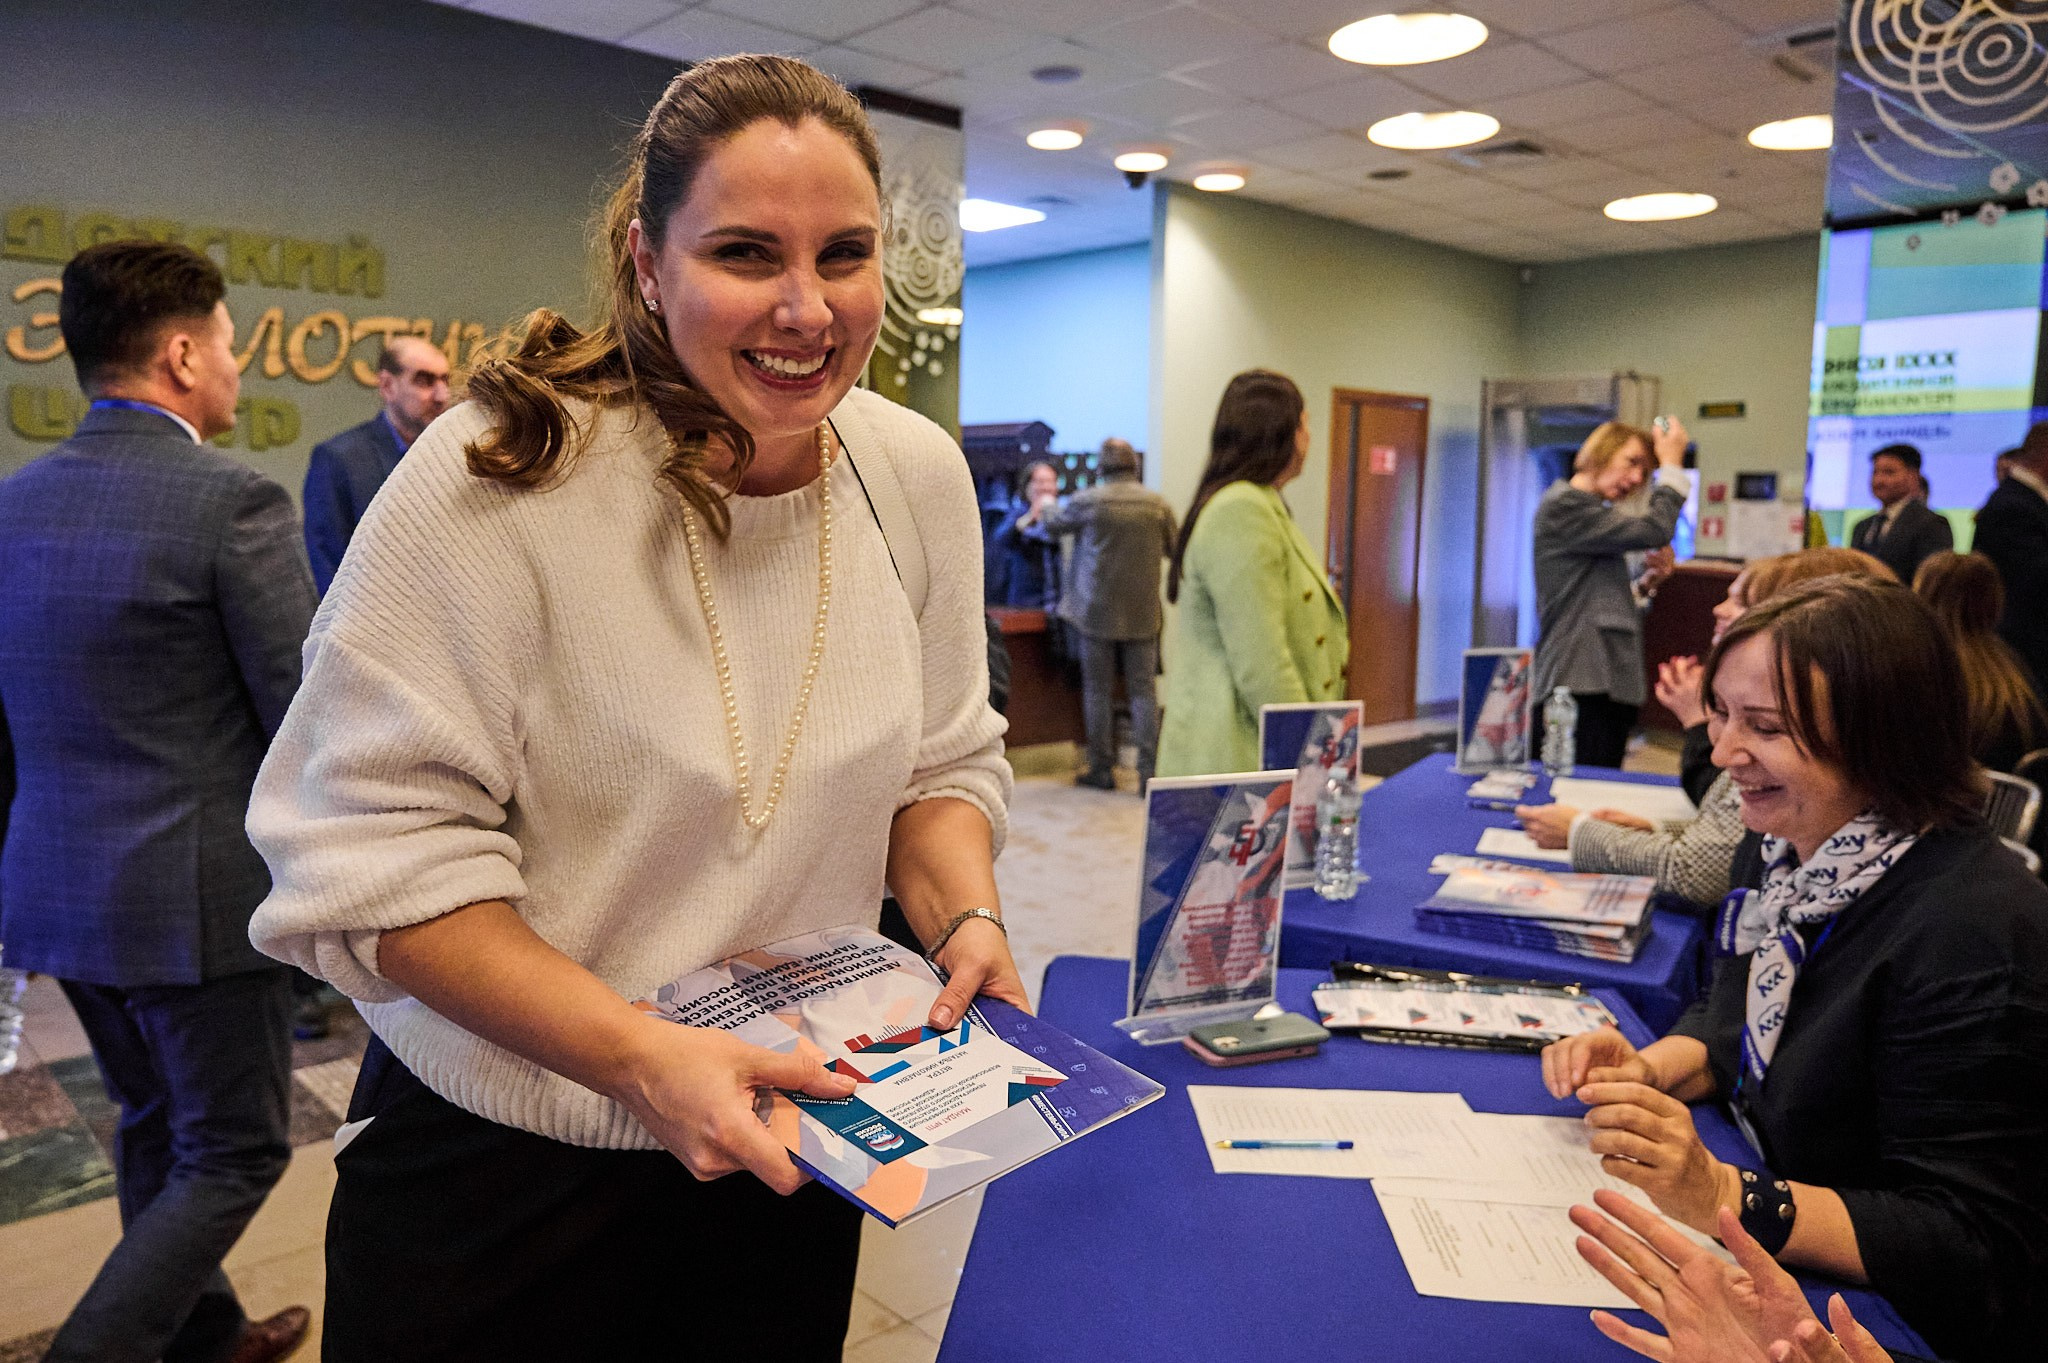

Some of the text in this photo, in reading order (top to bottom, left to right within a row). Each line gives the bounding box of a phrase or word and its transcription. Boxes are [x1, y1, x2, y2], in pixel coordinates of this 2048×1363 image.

[777, 943, 894, 983] ВСЕРОССИЙСКОЙ
[805, 943, 859, 963] ПАРТИИ
[778, 956, 886, 993] РЕГИОНАЛЬНОЕ
[787, 961, 901, 1002] ЛЕНИНГРАДСКОЕ
[677, 979, 778, 1025] ПОЛИТИЧЕСК
[718, 1000, 787, 1030] ОБЛАСТН
[893, 1050, 968, 1086] НАТАЛЬЯ НИКОЛАЕВНА
[926, 1066, 953, 1079] ВЕГЕРА
[957, 1064, 1001, 1086] ВСЕРОССИЙСКОЙ
[896, 1082, 976, 1121] РЕГИОНАЛЬНОГО ОТДЕЛЕНИЯ
[915, 1085, 958, 1107] ПОЛИТИЧЕСКОЙ
[937, 1083, 987, 1108] ЛЕНИНГРАДСКОГО
[891, 1105, 915, 1118] ПАРТИИ
[901, 1107, 939, 1125] ОБЛАСТНОГО
[908, 1108, 950, 1128] КОНФЕРЕНЦИЯ
[940, 1107, 972, 1124] МАНДАТ
